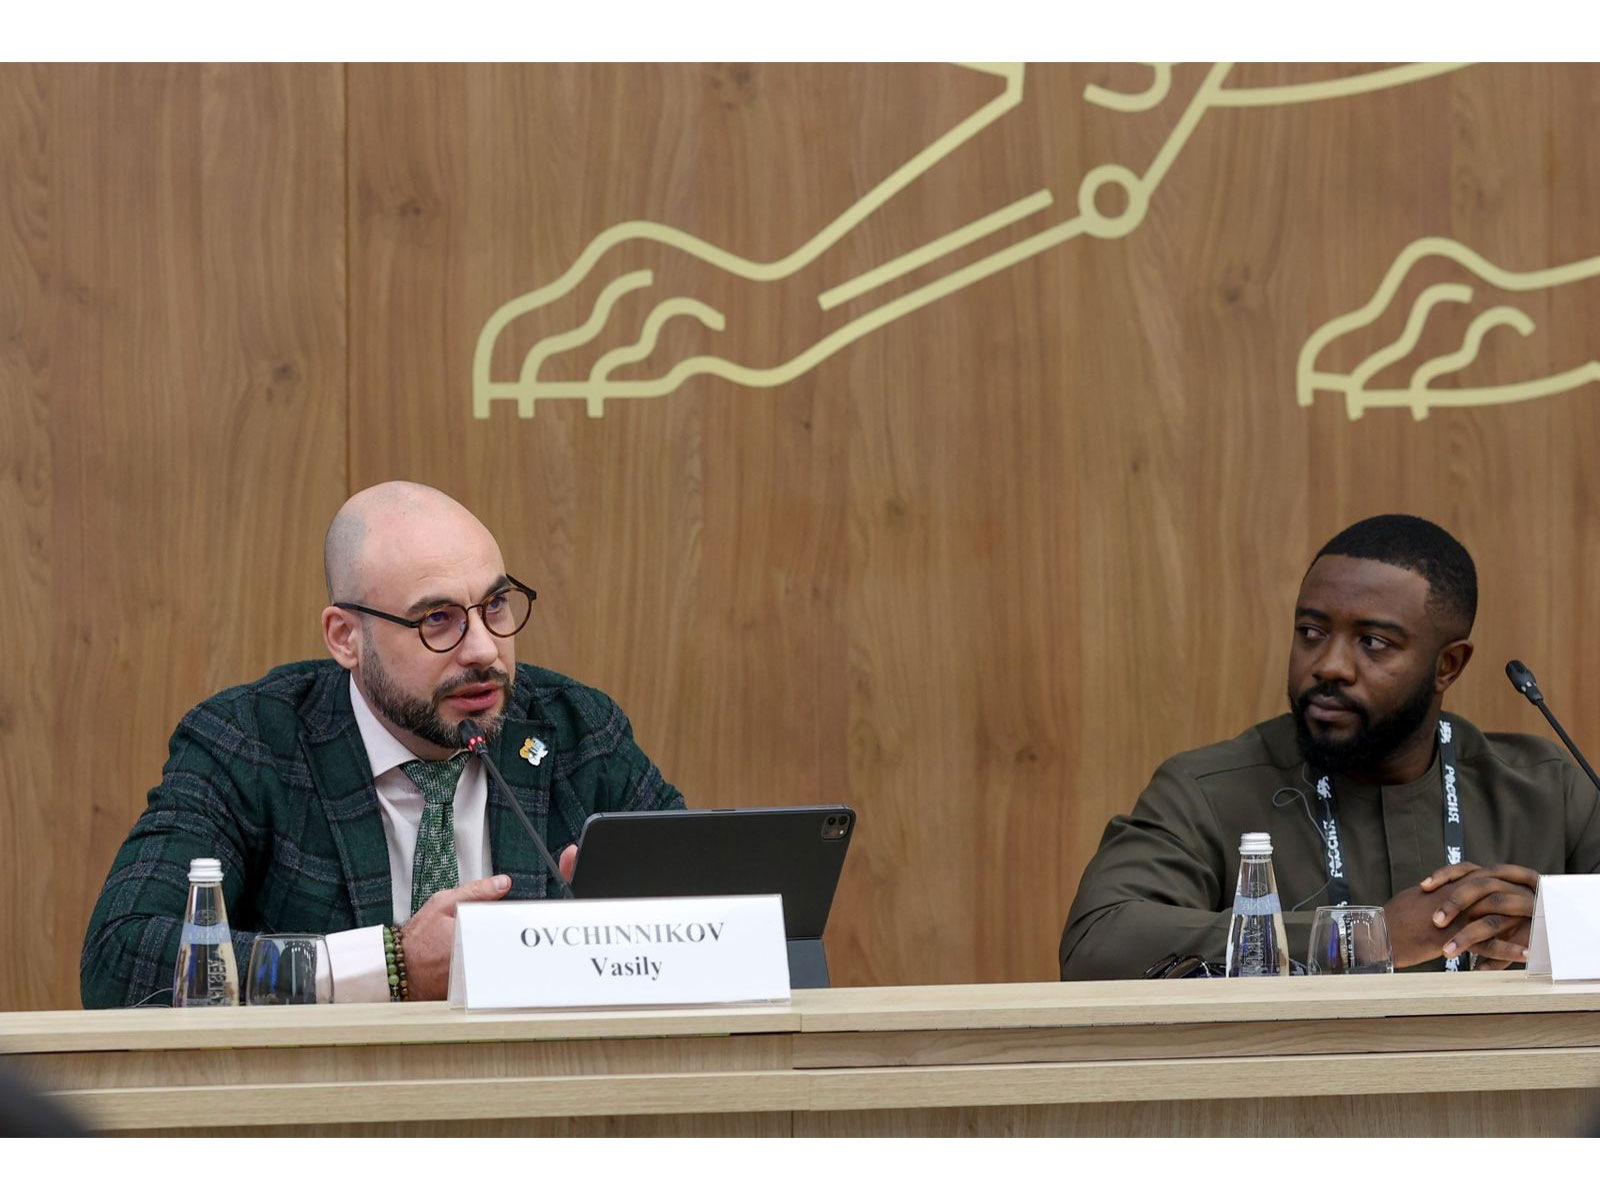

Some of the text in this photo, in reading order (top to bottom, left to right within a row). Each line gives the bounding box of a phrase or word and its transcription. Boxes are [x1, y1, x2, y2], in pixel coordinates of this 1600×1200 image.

[1445, 764, 1460, 824] РОССИЯ
[519, 921, 725, 948] OVCHINNIKOV
[589, 956, 663, 982] Vasily
